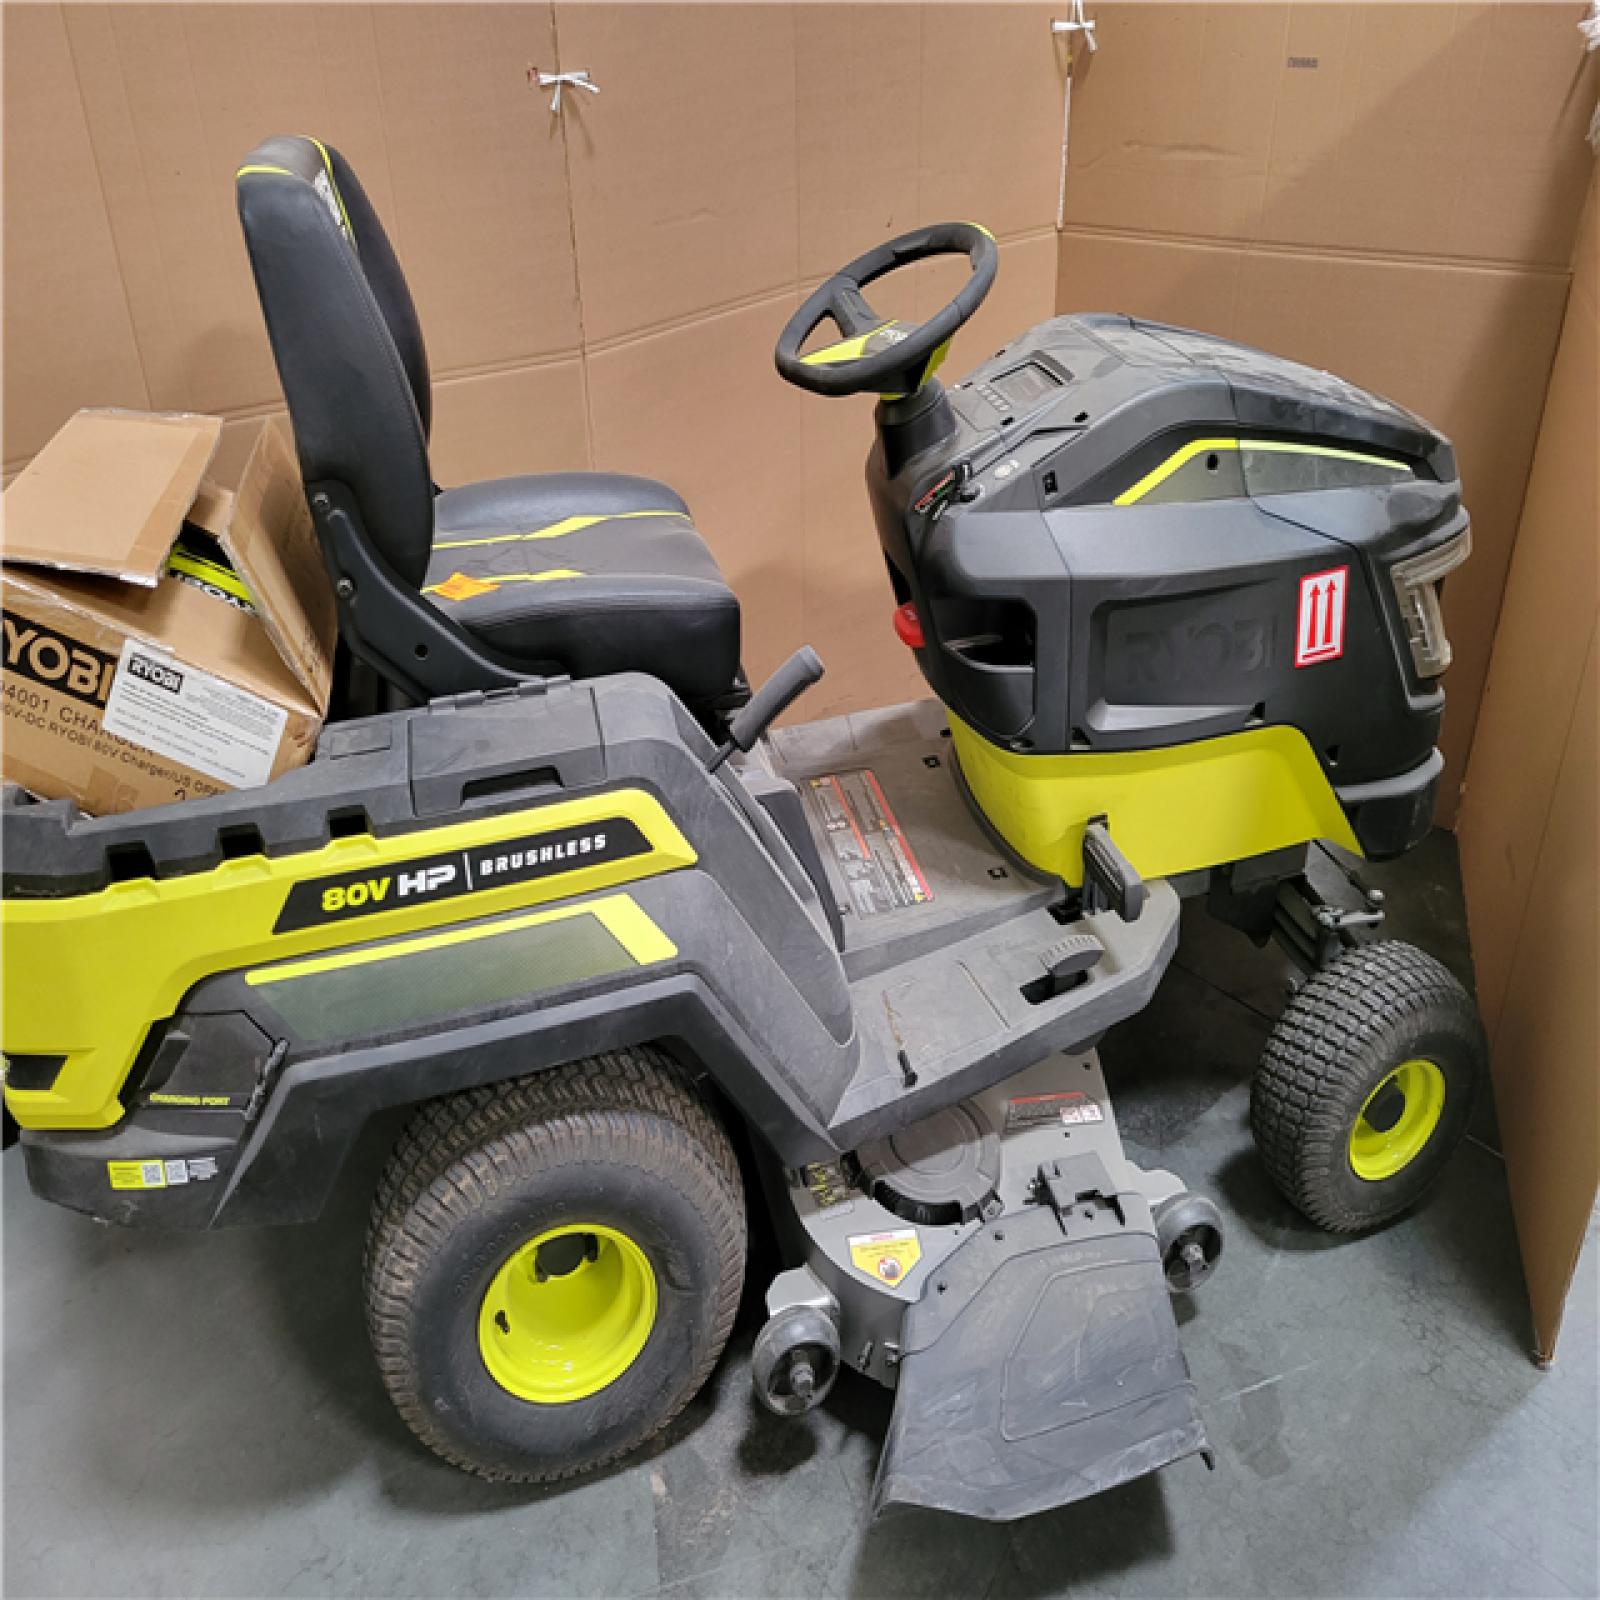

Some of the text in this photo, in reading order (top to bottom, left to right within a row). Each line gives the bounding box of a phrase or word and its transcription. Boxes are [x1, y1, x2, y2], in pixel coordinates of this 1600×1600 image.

[1, 683, 48, 713] 4001
[321, 833, 606, 911] 80V HP BRUSHLESS
